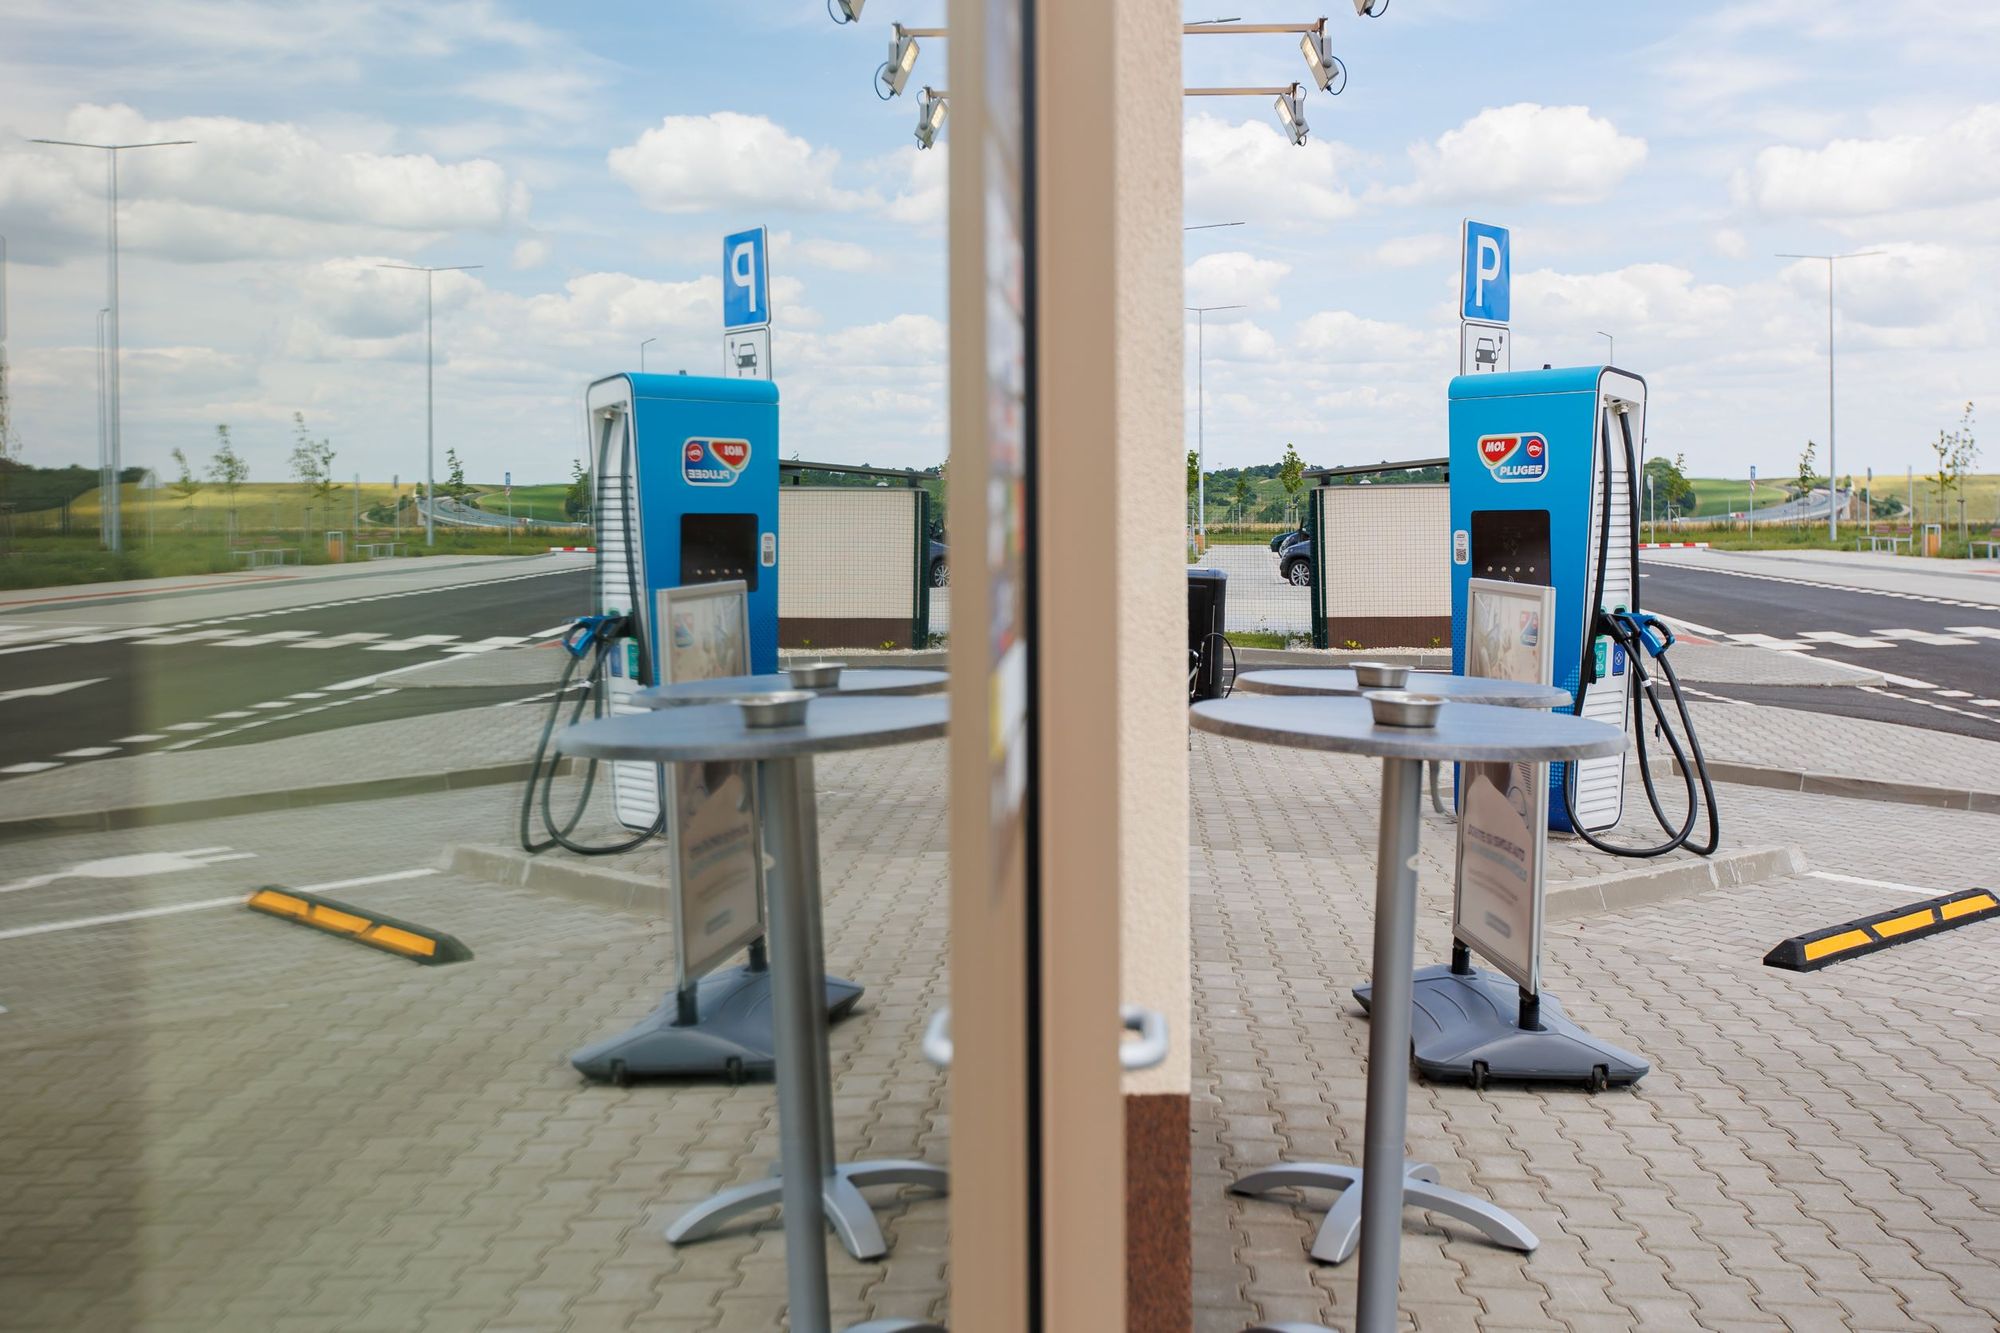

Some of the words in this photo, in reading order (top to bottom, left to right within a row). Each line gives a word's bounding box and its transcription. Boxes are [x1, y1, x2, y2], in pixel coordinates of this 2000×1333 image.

[1476, 235, 1500, 306] P
[1485, 441, 1505, 452] MOL
[1500, 465, 1542, 475] PLUGEE
